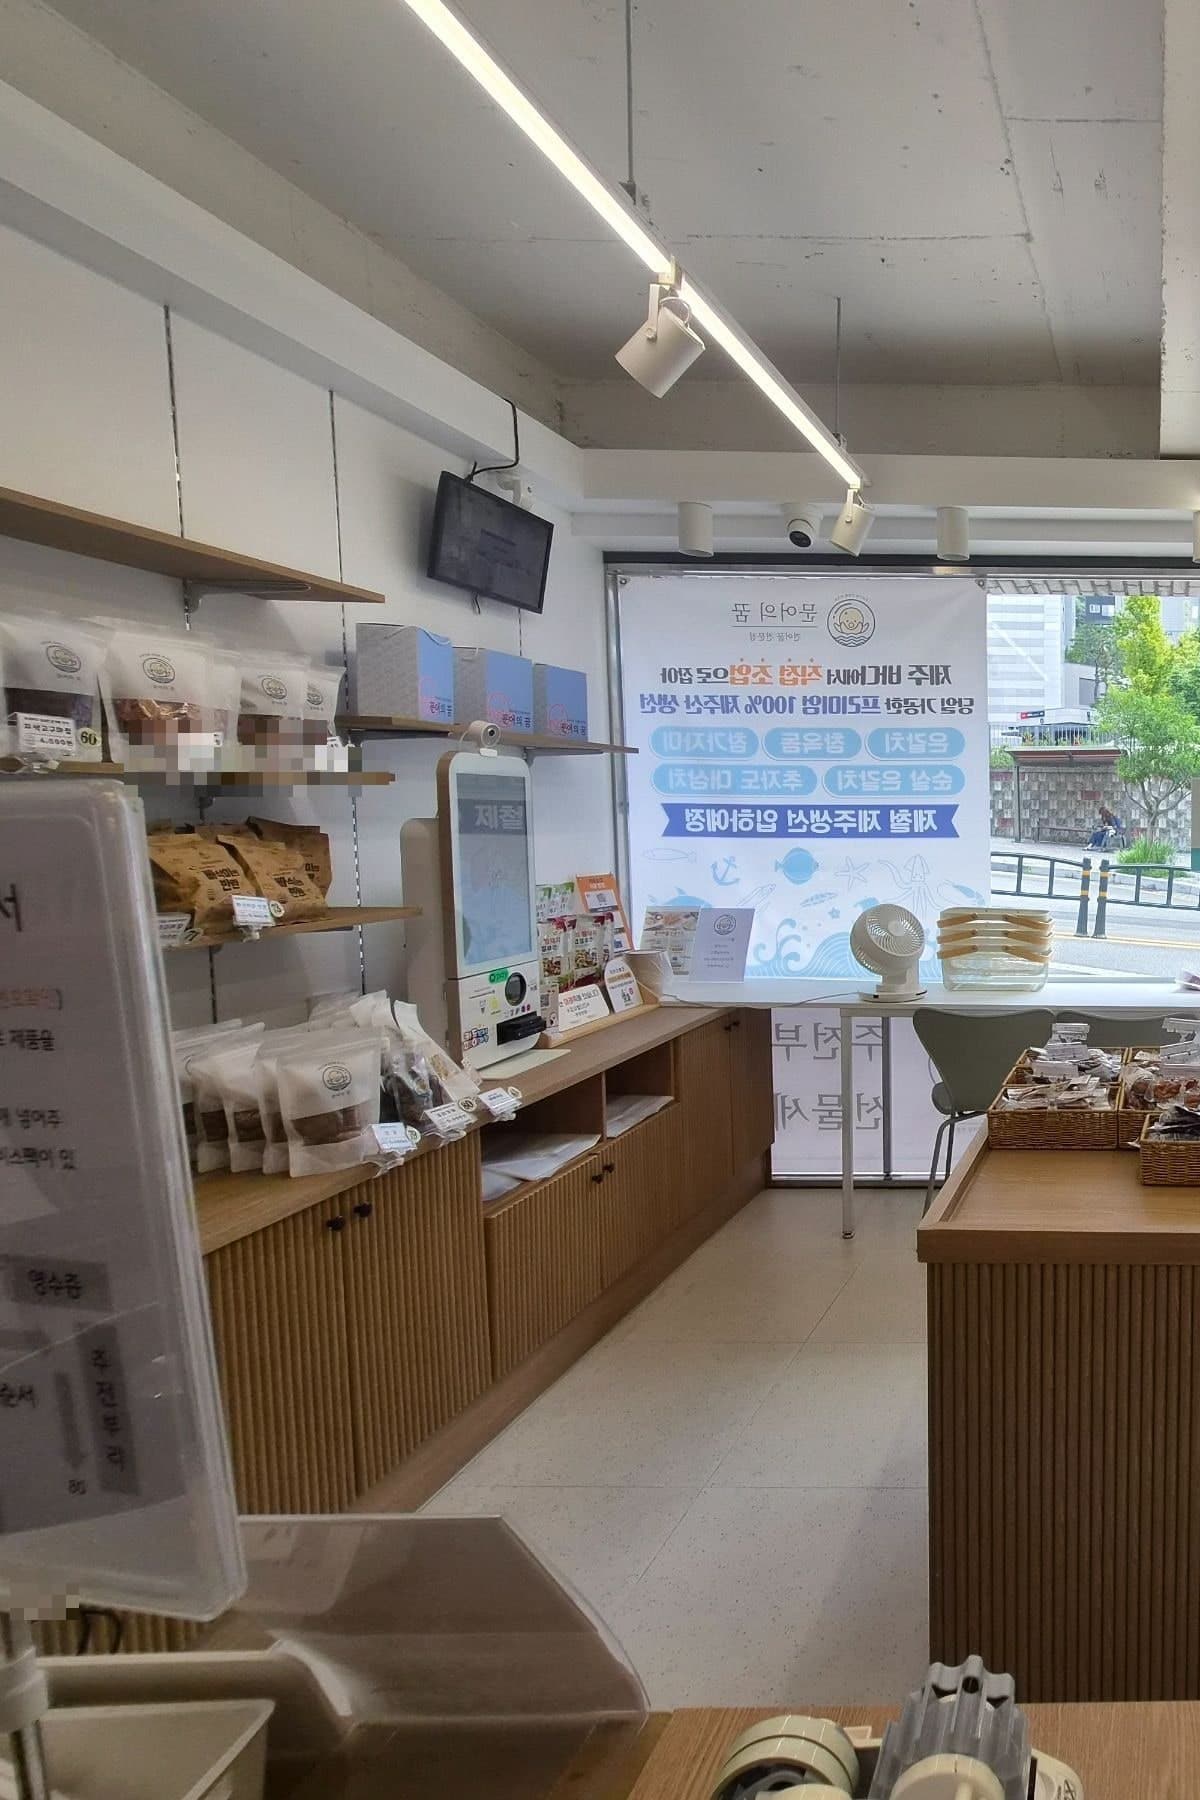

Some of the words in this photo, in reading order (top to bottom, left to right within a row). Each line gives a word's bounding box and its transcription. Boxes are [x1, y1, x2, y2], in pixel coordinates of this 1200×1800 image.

[80, 730, 98, 746] 60
[8, 1028, 56, 1052] 제품을
[28, 1269, 84, 1300] 영수증
